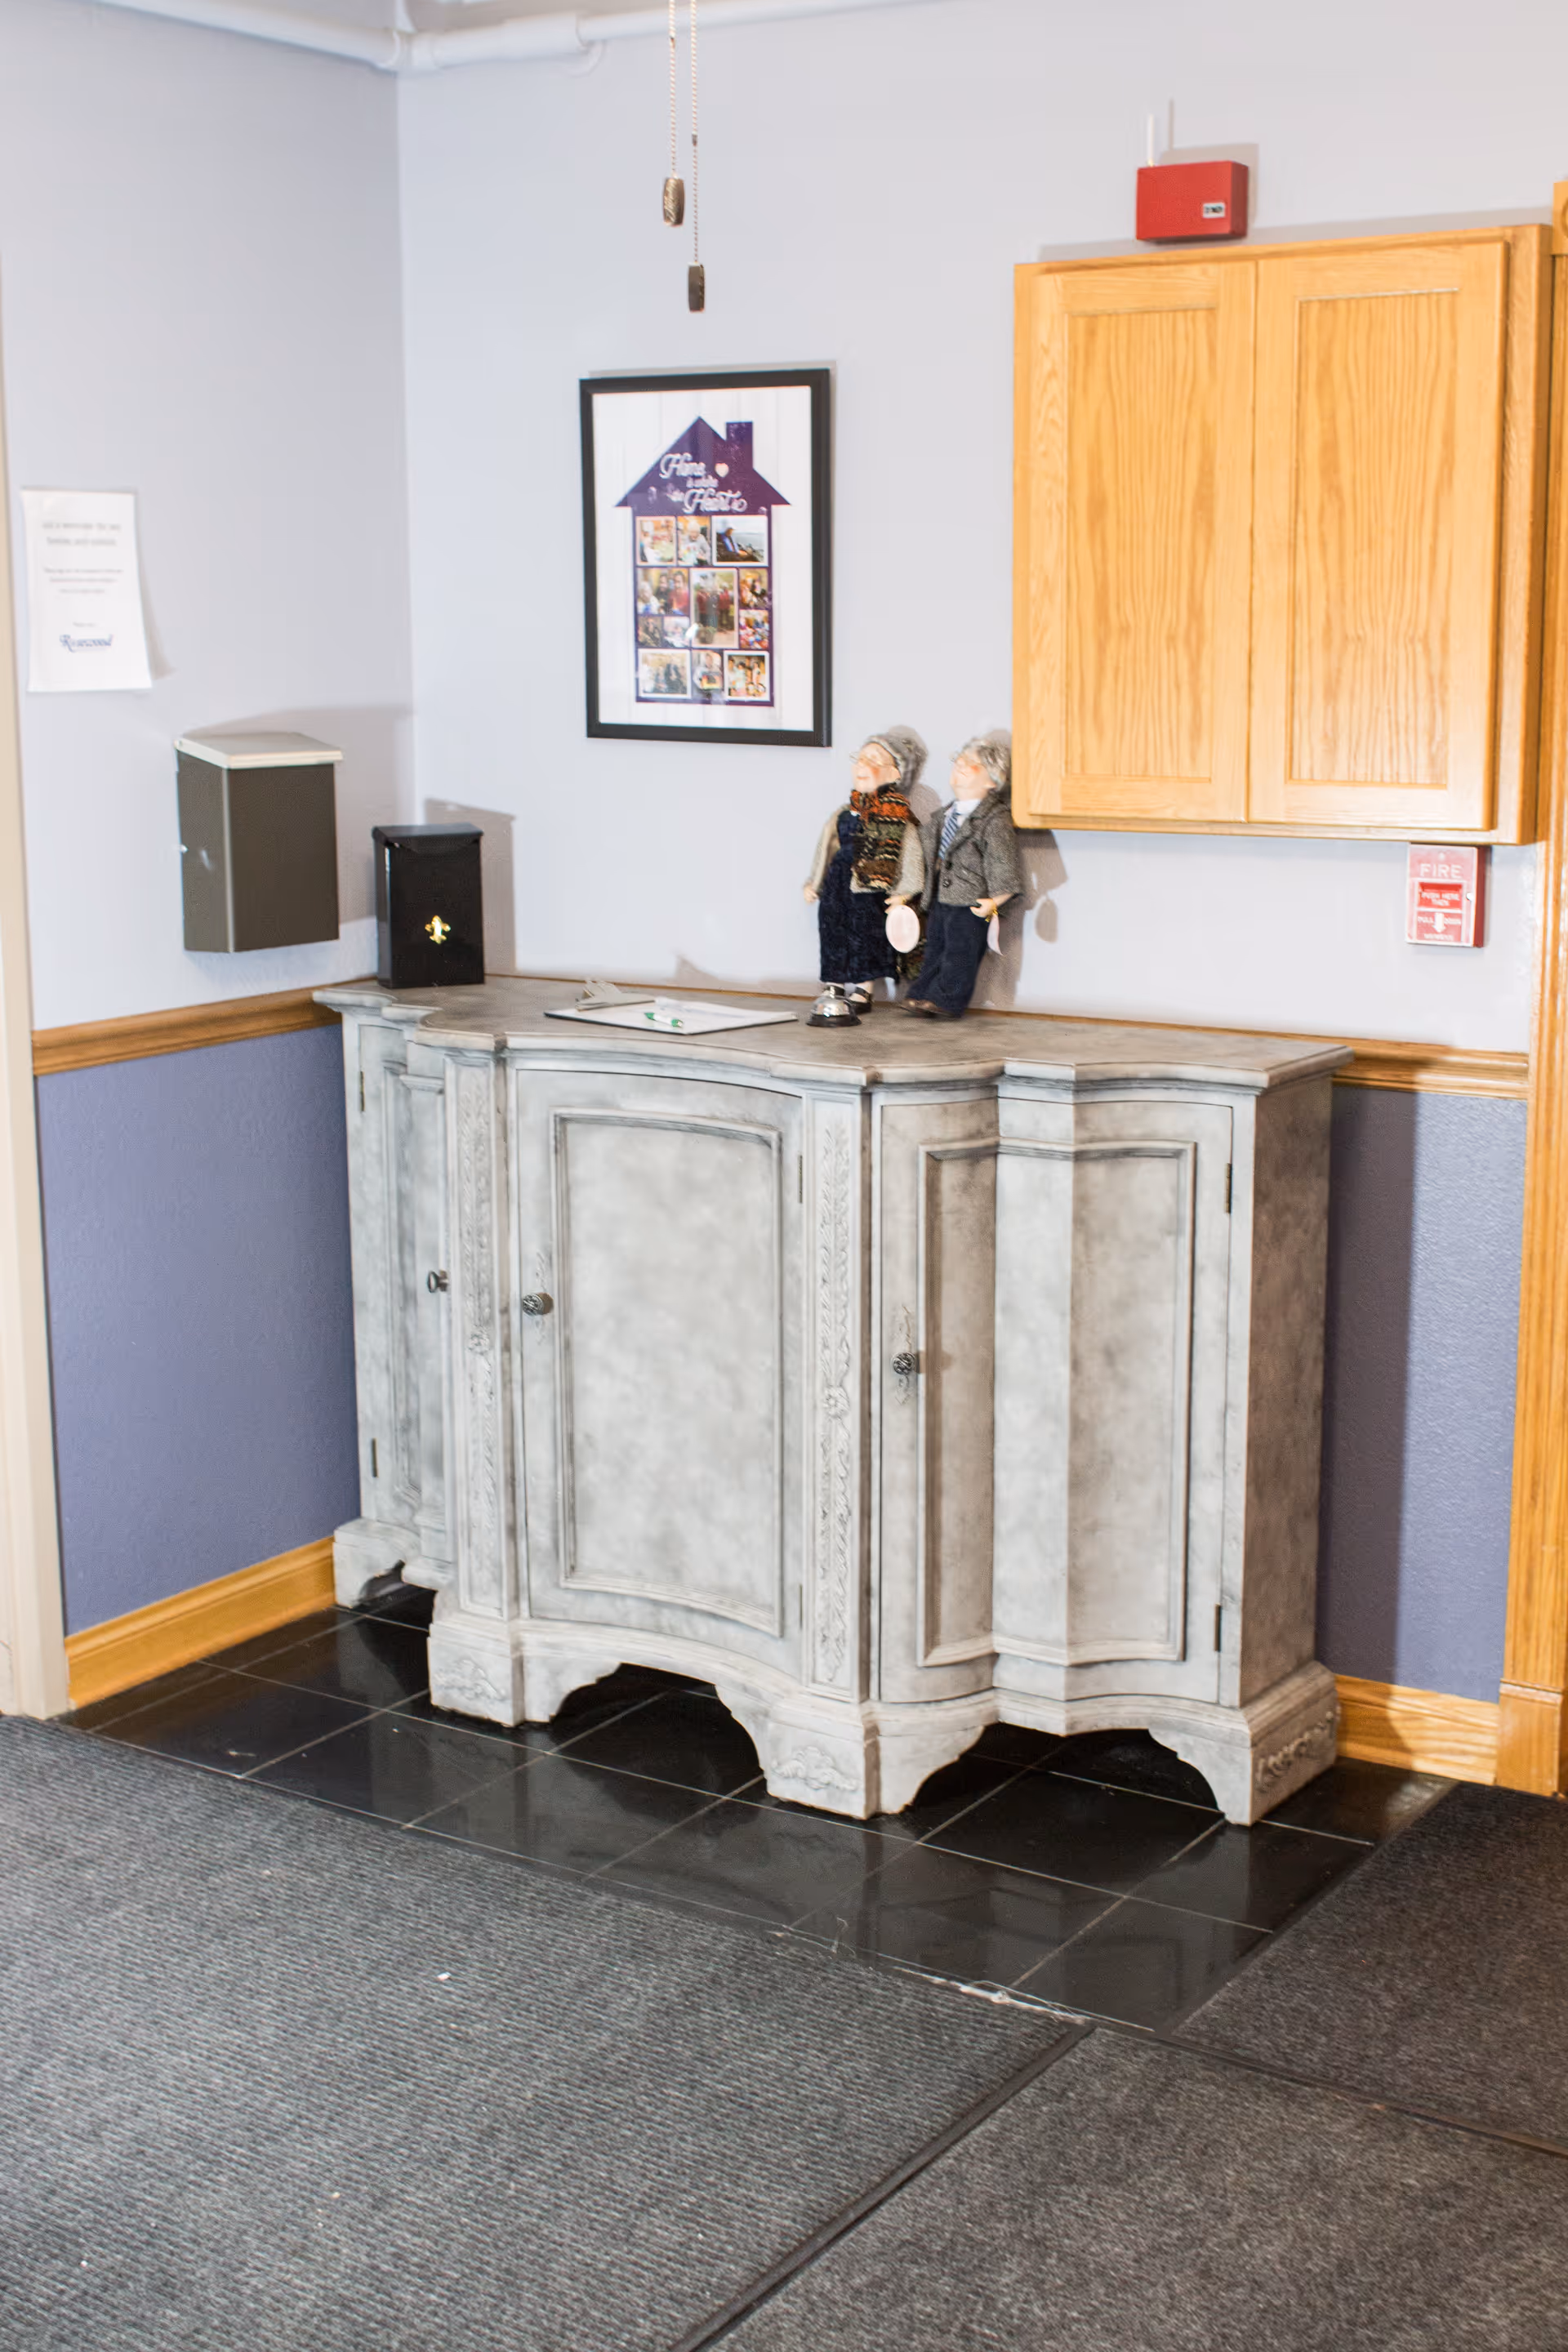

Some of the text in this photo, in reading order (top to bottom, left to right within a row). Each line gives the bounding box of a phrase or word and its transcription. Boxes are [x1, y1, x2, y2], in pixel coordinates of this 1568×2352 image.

[1419, 863, 1463, 880] FIRE
[1421, 891, 1441, 900] PUSH
[1417, 915, 1434, 924] PULL
